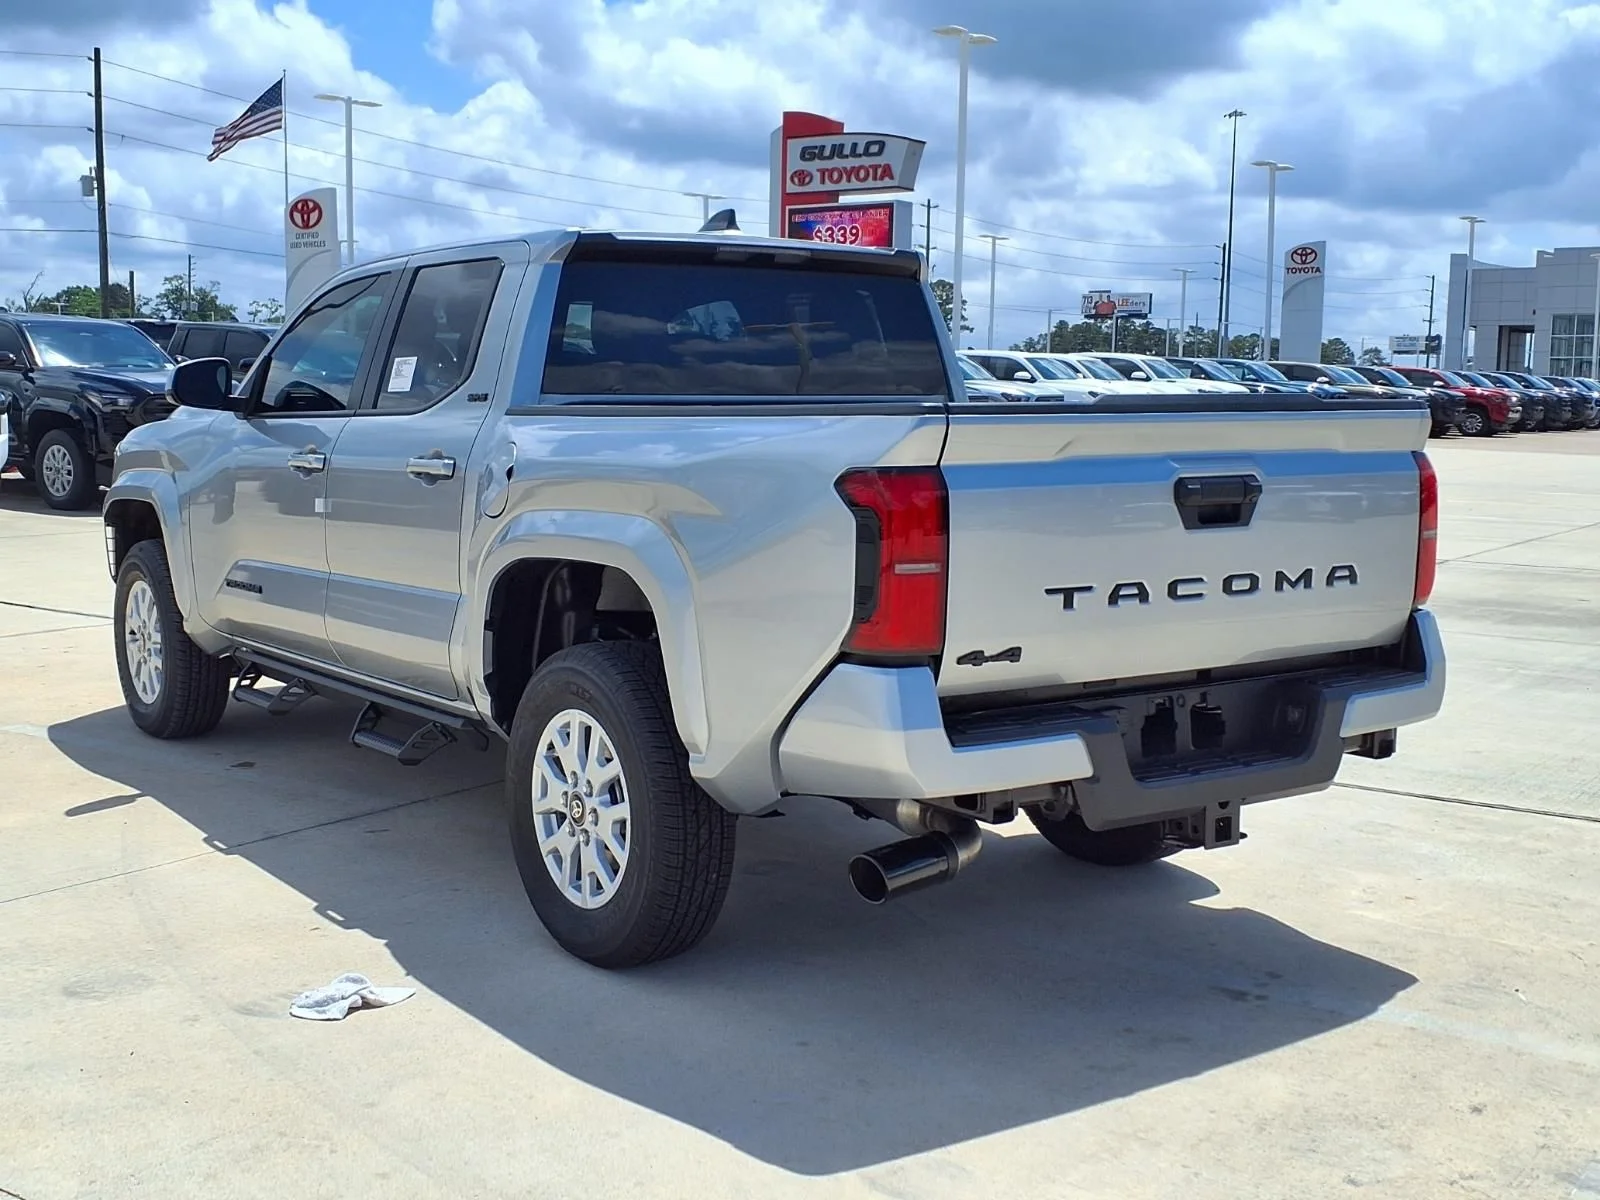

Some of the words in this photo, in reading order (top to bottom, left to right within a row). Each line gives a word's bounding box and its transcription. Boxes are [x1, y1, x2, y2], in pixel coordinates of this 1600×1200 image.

[799, 140, 886, 162] GULLO
[816, 163, 894, 185] TOYOTA
[295, 232, 320, 240] CERTIFIED
[290, 241, 302, 249] USED
[303, 240, 326, 248] VEHICLES
[1286, 266, 1321, 274] TOYOTA
[1044, 564, 1359, 612] TACOMA
